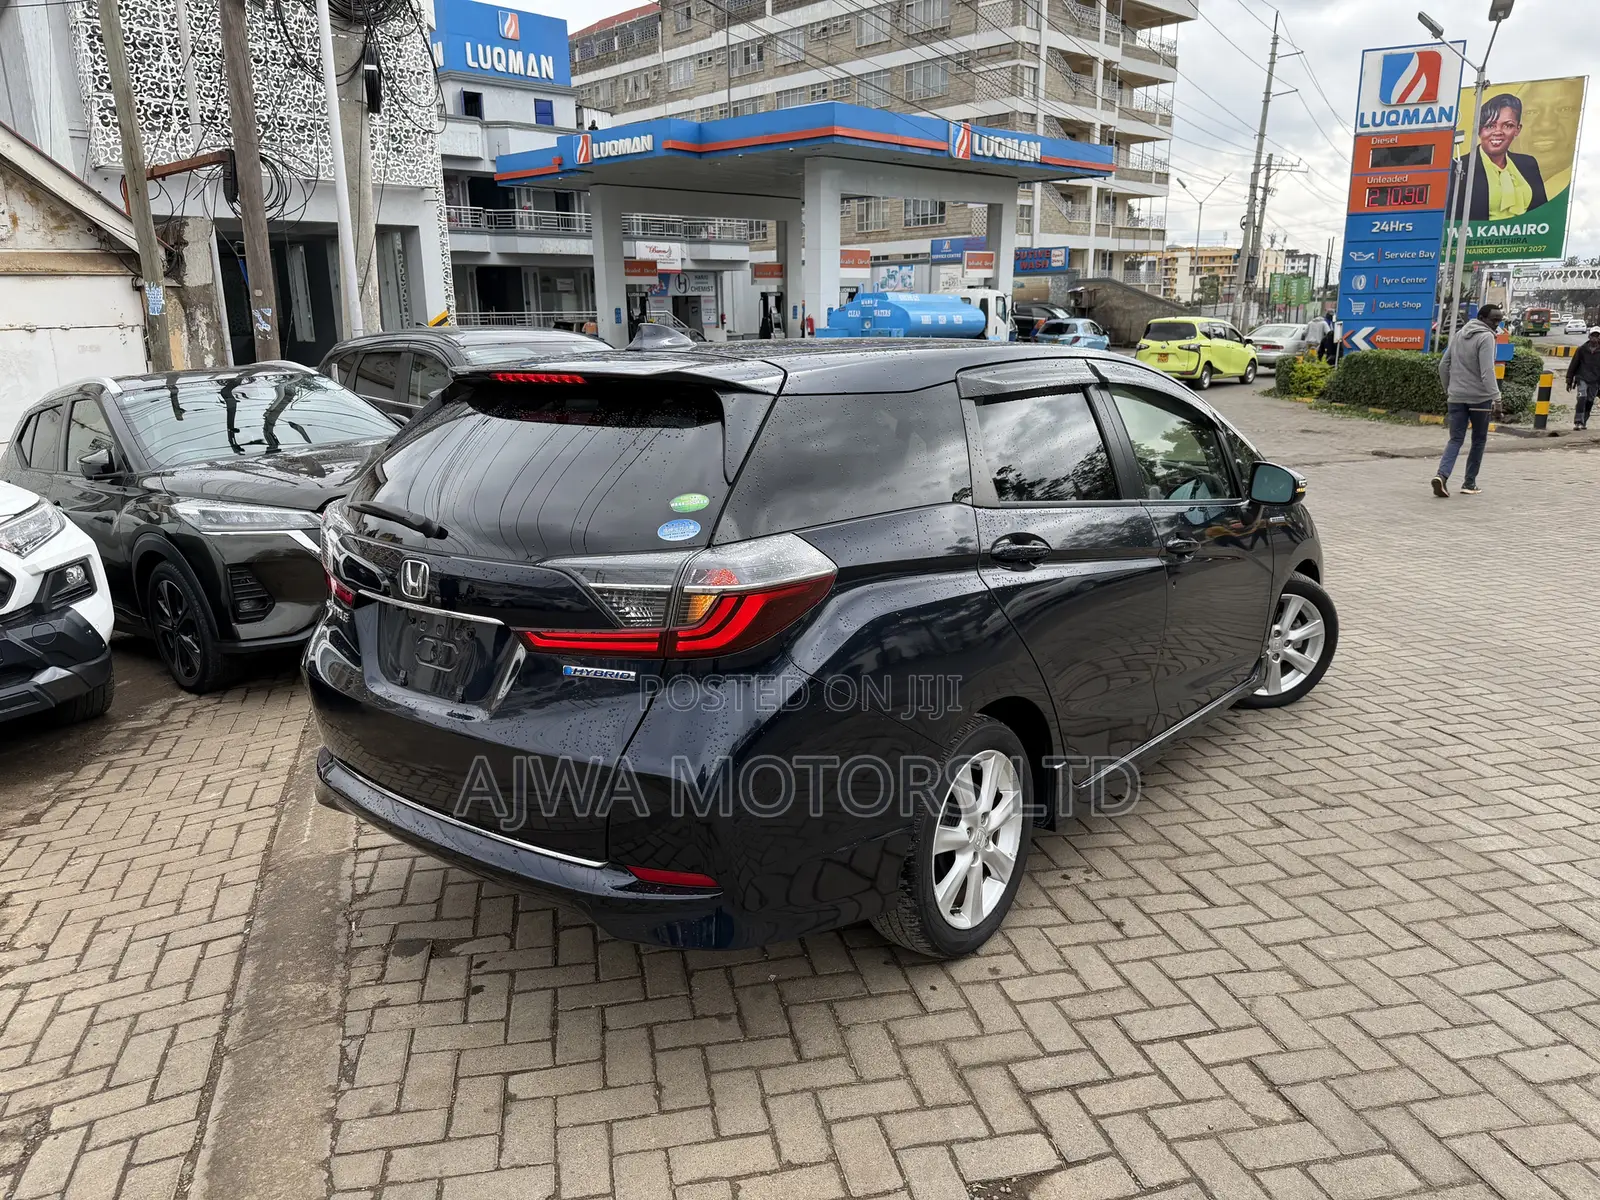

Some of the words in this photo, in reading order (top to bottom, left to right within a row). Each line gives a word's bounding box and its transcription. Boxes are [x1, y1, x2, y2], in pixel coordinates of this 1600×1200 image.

[465, 42, 554, 80] LUQMAN
[1359, 105, 1454, 129] LUQMAN
[1371, 136, 1398, 145] Diesel
[592, 134, 653, 159] LUQMAN
[972, 133, 1042, 163] LUQMAN
[1367, 174, 1408, 184] Unleaded
[1371, 221, 1413, 233] 24Hrs
[1477, 223, 1550, 238] KANAIRO
[1485, 238, 1528, 246] WAITHIRA
[1015, 249, 1051, 261] CUTIVE
[1384, 251, 1416, 260] Service
[1419, 250, 1436, 261] Bay
[1466, 247, 1496, 255] NAIROBI
[1528, 245, 1547, 253] 2027
[1020, 260, 1049, 271] WASH
[1382, 276, 1398, 286] Tyre
[1400, 276, 1428, 285] Center
[1379, 300, 1399, 310] Quick
[1402, 301, 1422, 310] Shop
[1375, 334, 1421, 344] Restaurant
[573, 667, 631, 680] HYBRID
